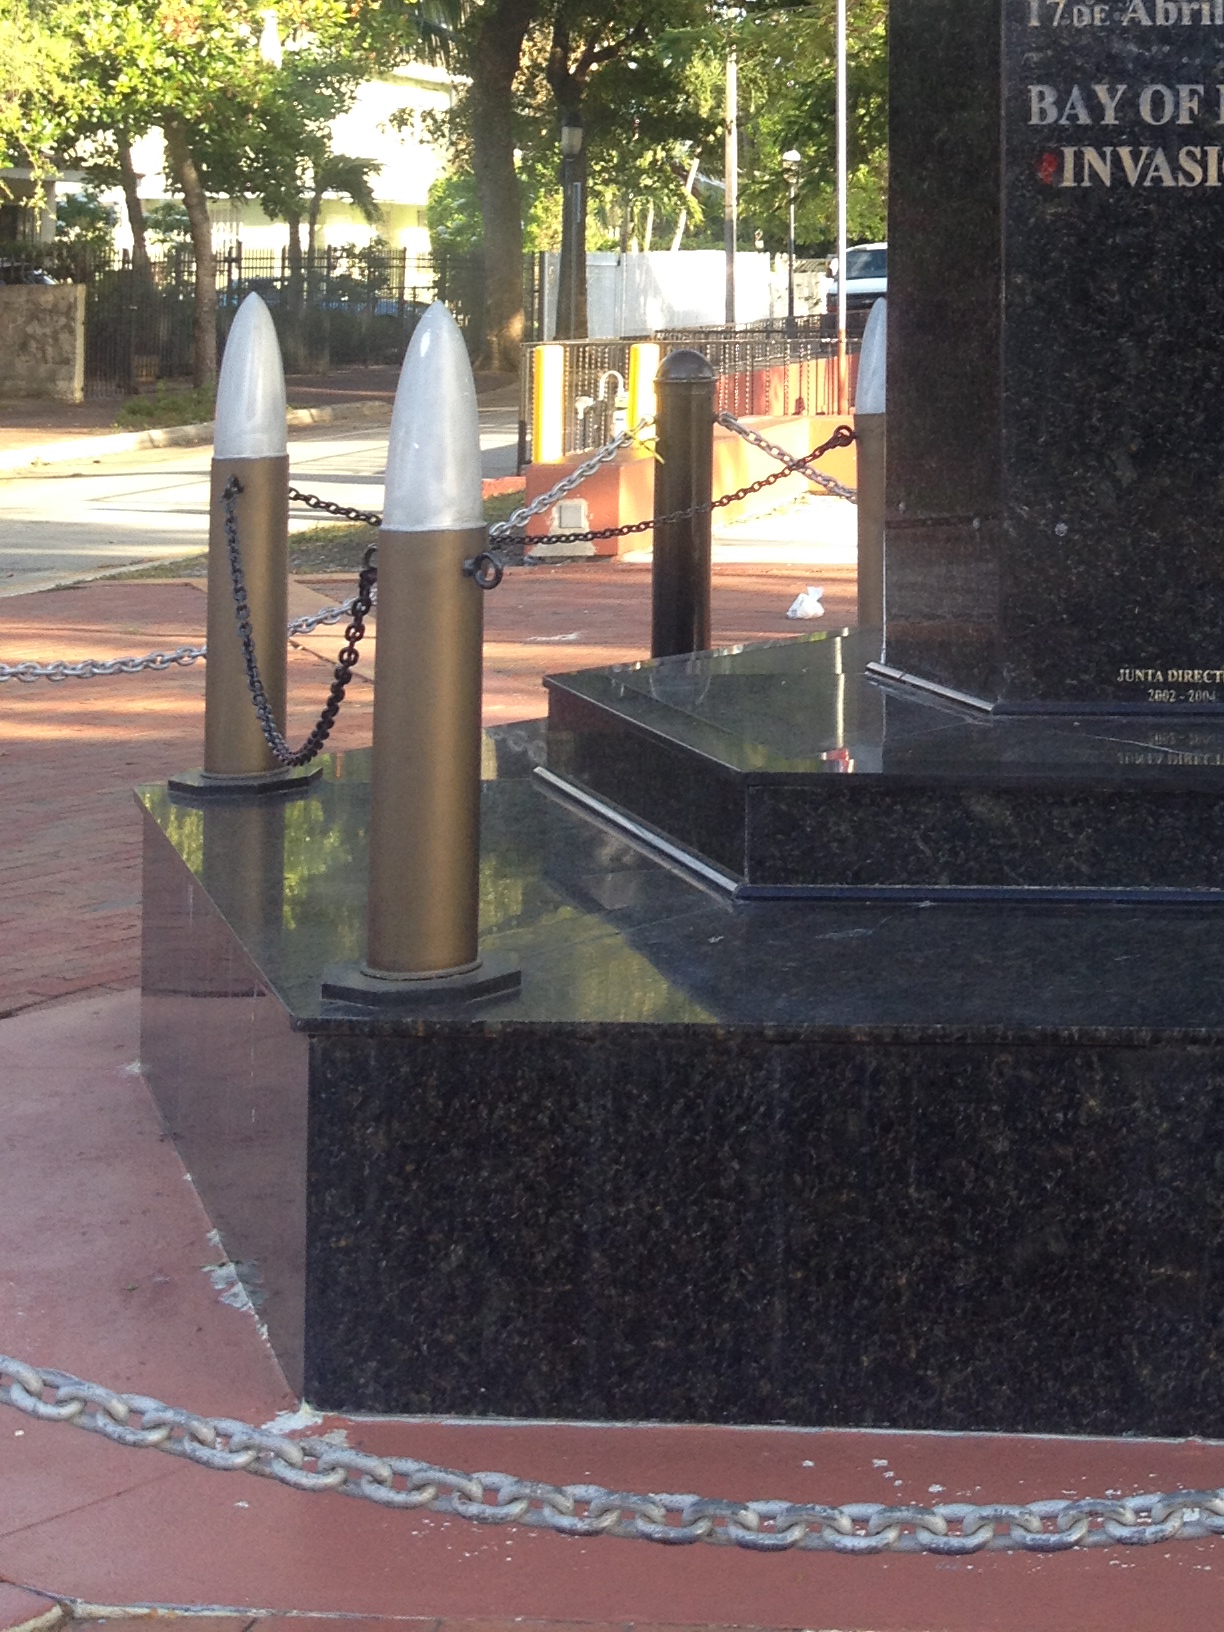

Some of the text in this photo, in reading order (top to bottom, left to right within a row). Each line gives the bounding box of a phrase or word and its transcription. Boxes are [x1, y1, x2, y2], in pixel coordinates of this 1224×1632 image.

[1027, 84, 1128, 126] BAY
[1138, 84, 1205, 126] OF
[1117, 668, 1164, 683] JUNTA
